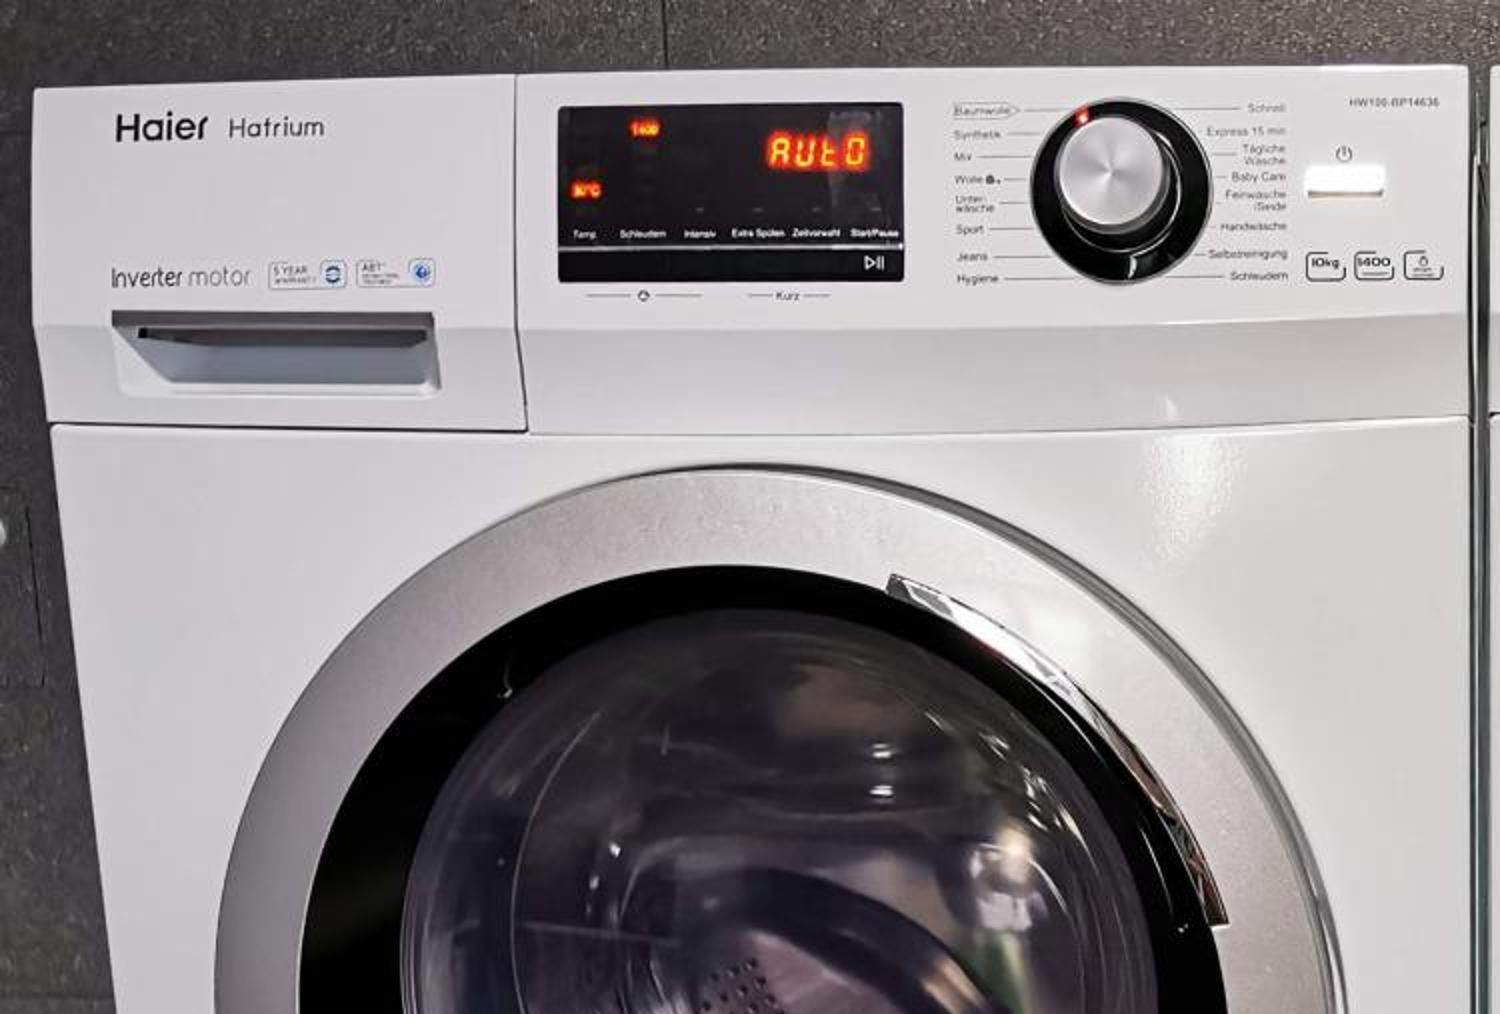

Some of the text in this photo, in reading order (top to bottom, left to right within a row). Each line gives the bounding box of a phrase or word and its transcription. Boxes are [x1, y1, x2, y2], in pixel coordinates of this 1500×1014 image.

[115, 110, 326, 143] Haier Hatrium
[1207, 127, 1249, 138] Express
[1252, 127, 1265, 136] 15
[954, 153, 972, 161] Mix
[1231, 171, 1287, 183] Baby Care
[684, 229, 717, 239] Intensiv
[731, 228, 754, 238] Extra
[957, 224, 985, 235] Sport
[957, 252, 988, 262] Jeans
[111, 267, 252, 289] Inverter motor
[957, 274, 999, 285] Hygiene
[776, 291, 800, 301] Kurz
